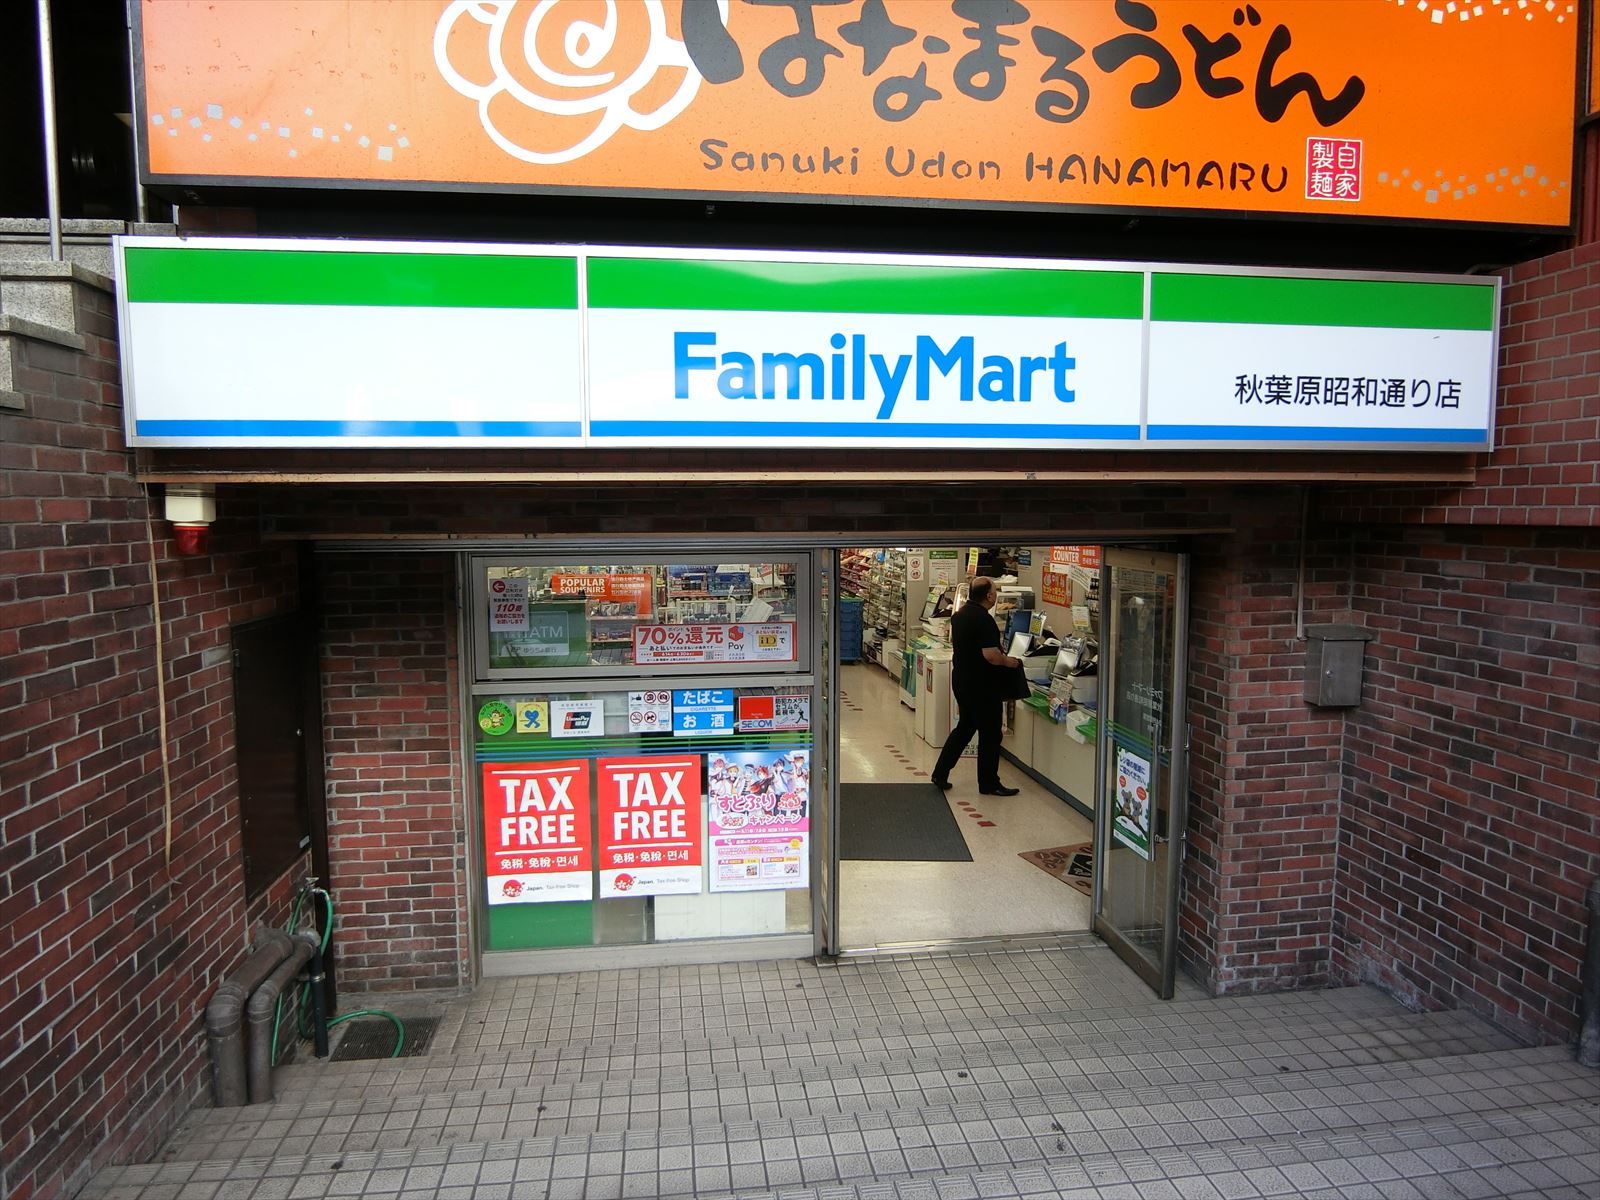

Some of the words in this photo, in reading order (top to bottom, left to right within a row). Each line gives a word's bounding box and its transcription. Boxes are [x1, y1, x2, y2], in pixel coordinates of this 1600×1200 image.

[681, 0, 1366, 127] はなまるうどん
[699, 138, 861, 178] Sanuki
[885, 145, 1000, 181] Udon
[1025, 152, 1290, 194] HANAMARU
[673, 331, 1076, 420] FamilyMart
[1233, 373, 1463, 410] 秋葉原昭和通り店
[1053, 550, 1080, 563] COUNTER
[560, 578, 605, 587] POPULAR
[728, 642, 745, 651] Pay
[682, 690, 725, 705] たばこ
[682, 713, 725, 728] お酒
[741, 719, 773, 729] SECOM
[500, 776, 574, 813] TAX
[612, 771, 685, 808] TAX
[501, 814, 576, 846] FREE
[613, 809, 687, 841] FREE
